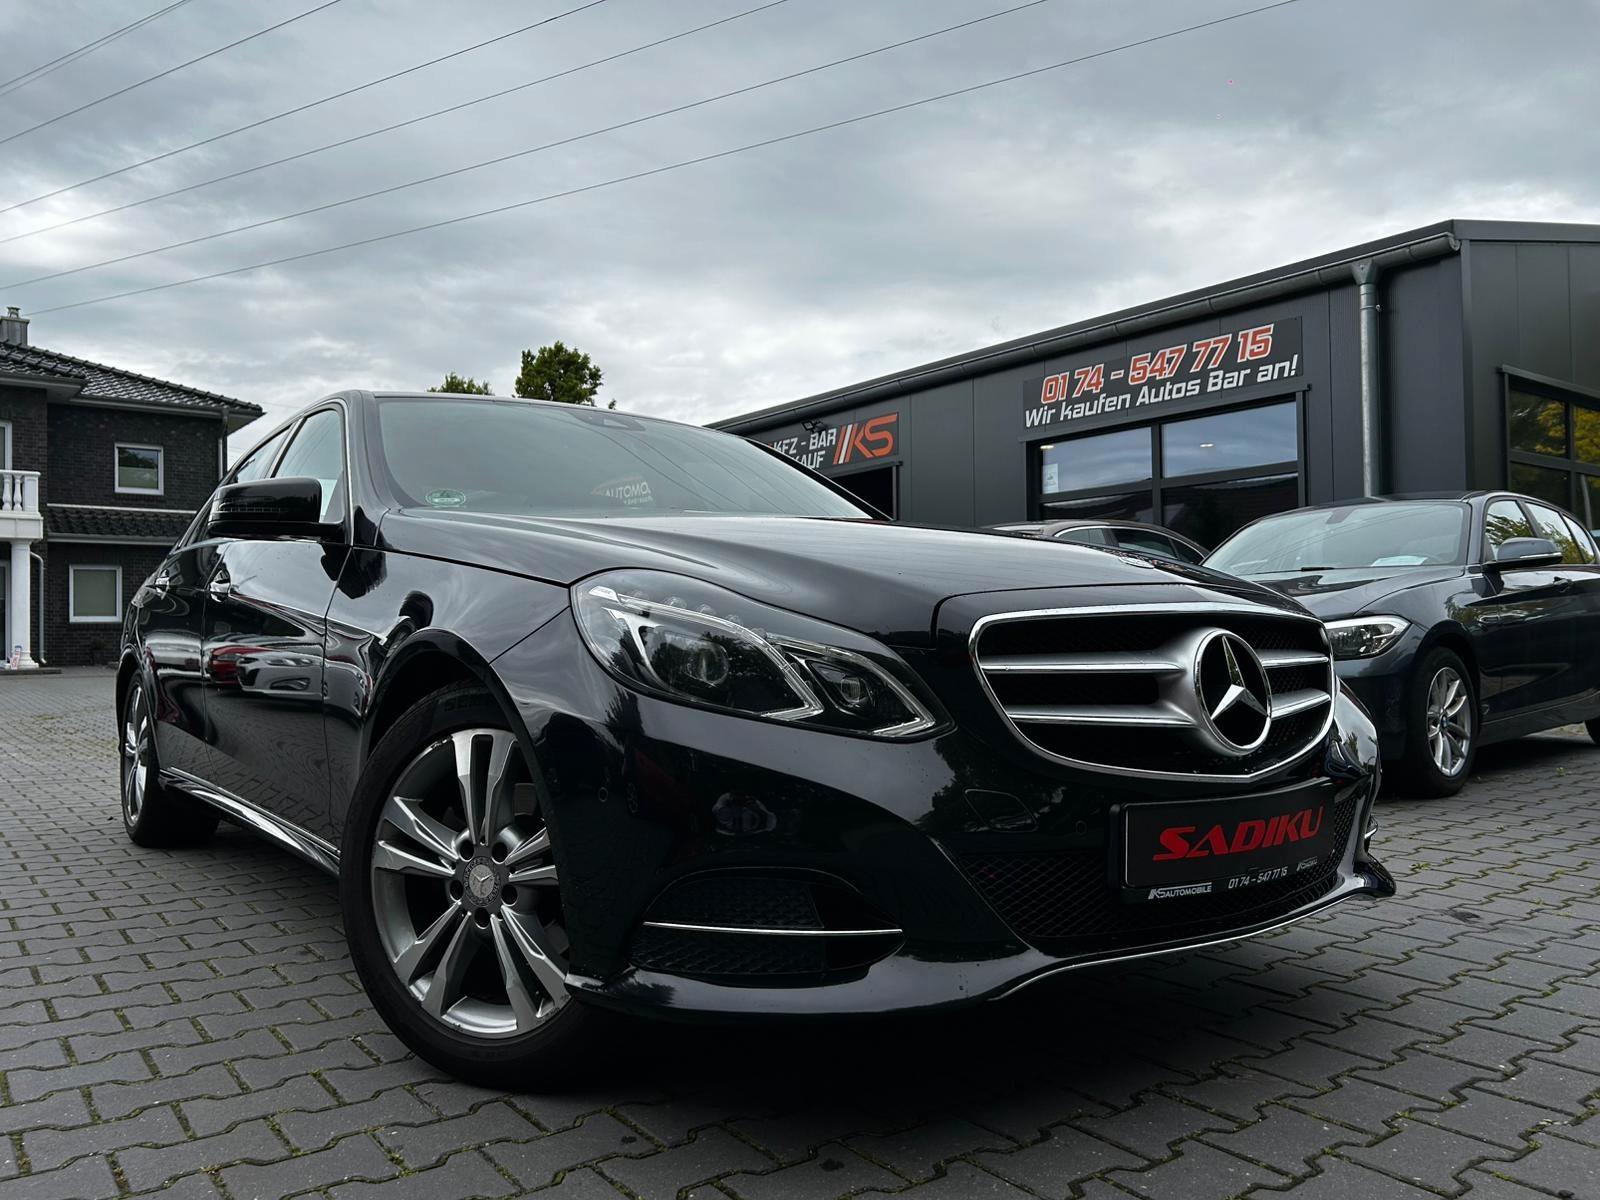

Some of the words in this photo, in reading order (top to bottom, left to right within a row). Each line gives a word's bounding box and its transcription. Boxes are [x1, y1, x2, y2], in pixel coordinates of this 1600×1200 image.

[1128, 345, 1187, 386] 547
[1189, 334, 1232, 373] 77
[1237, 323, 1274, 362] 15
[1025, 407, 1056, 428] Wir
[1060, 391, 1131, 421] kaufen
[1136, 380, 1200, 406] Autos
[1206, 367, 1251, 392] Bar
[1256, 354, 1298, 383] an!
[792, 450, 826, 469] AUF
[809, 428, 837, 450] BAR
[1152, 805, 1325, 861] SADIKU
